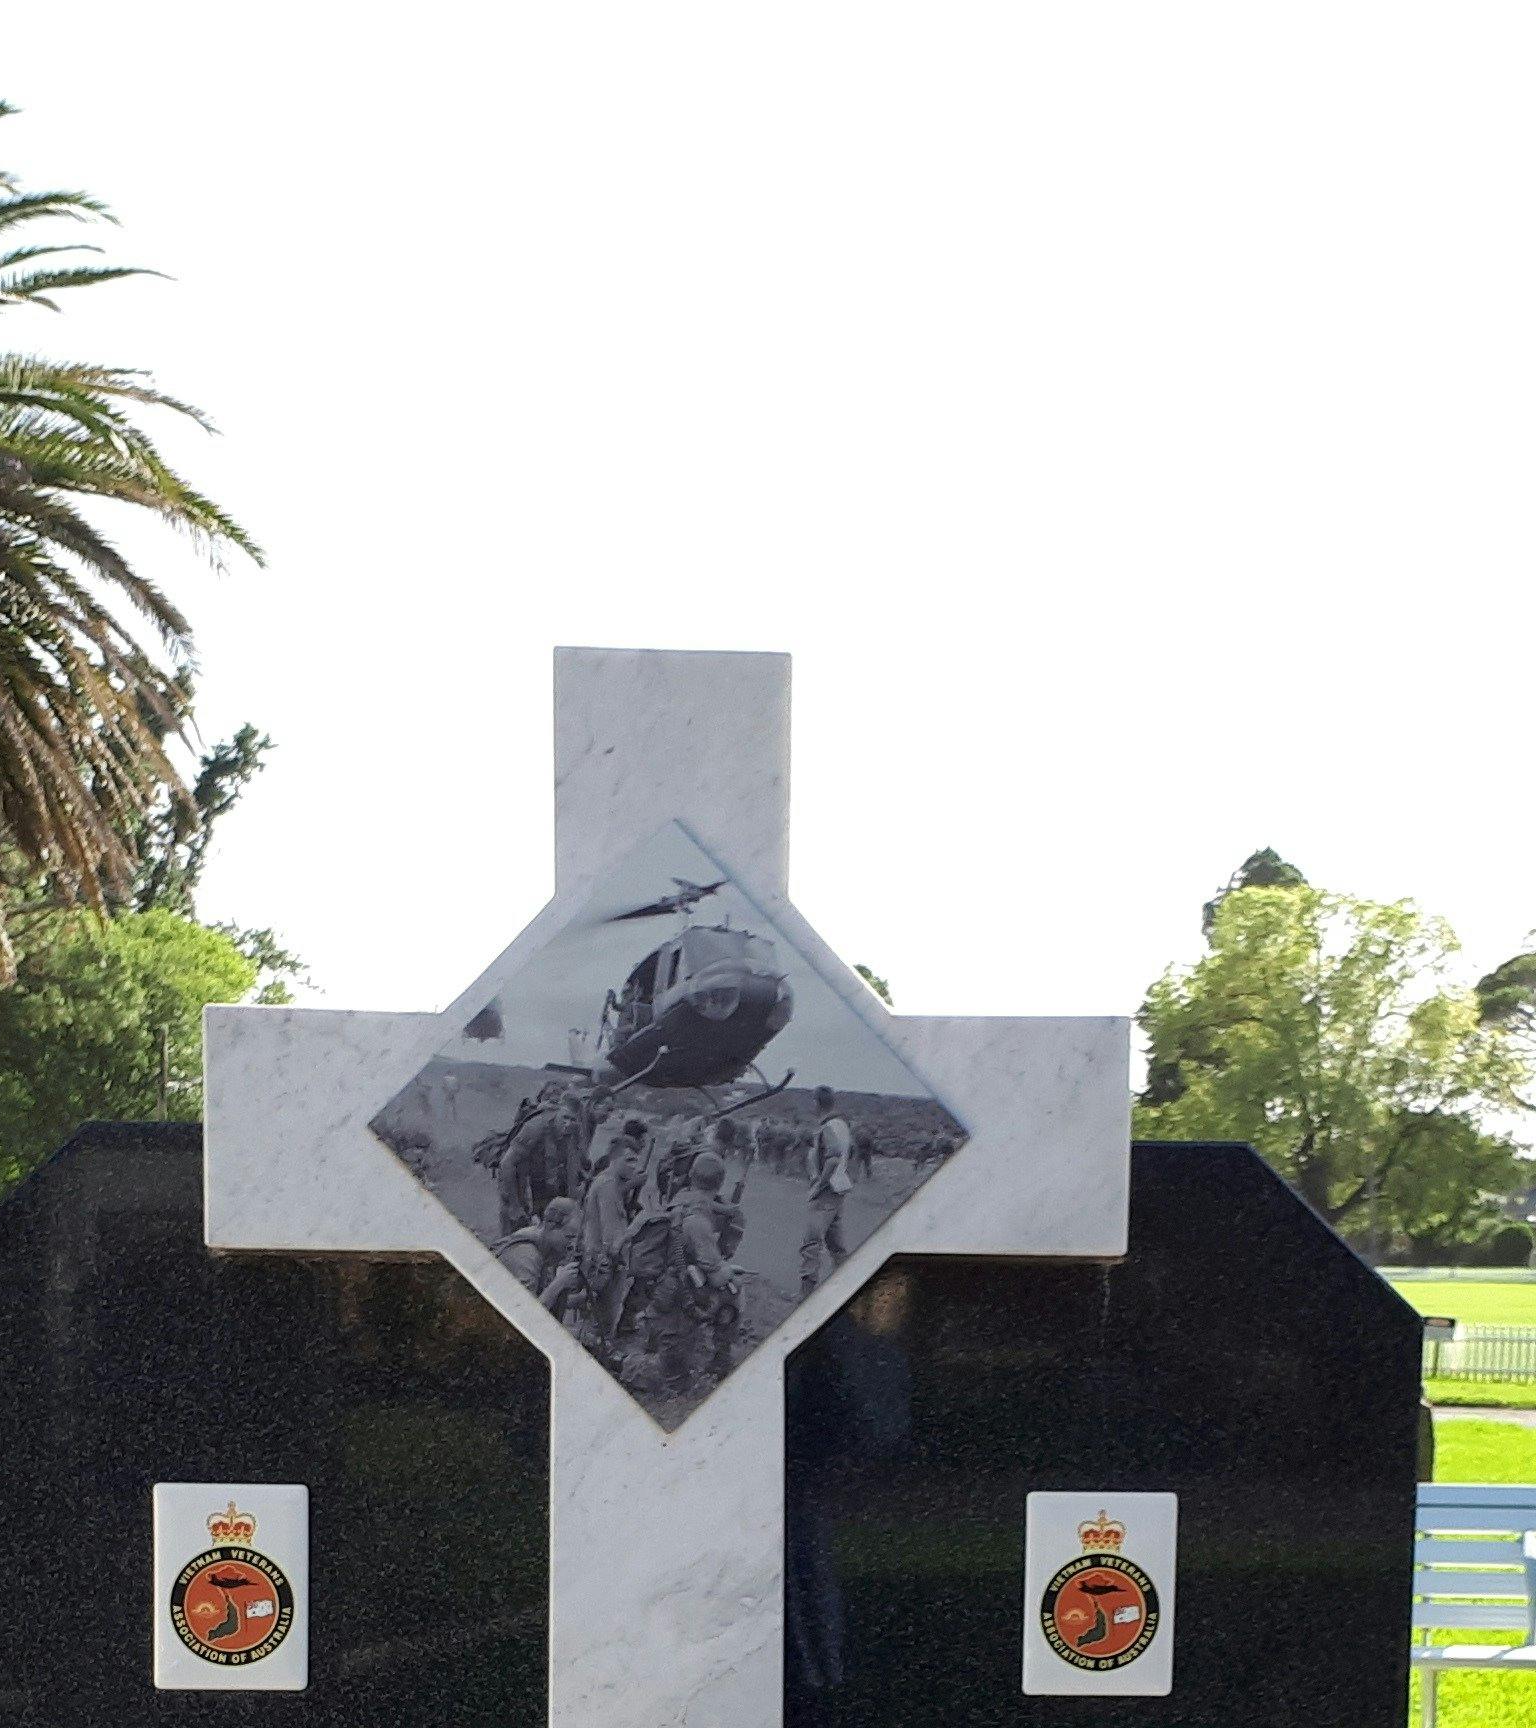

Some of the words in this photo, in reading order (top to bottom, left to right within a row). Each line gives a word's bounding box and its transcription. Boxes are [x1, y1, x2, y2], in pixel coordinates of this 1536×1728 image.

[179, 1550, 222, 1585] VIETNAM
[229, 1550, 285, 1586] VETERANS
[172, 1604, 226, 1663] ASSOCIATION
[231, 1652, 247, 1663] OF
[251, 1606, 292, 1662] AUSTRALIA
